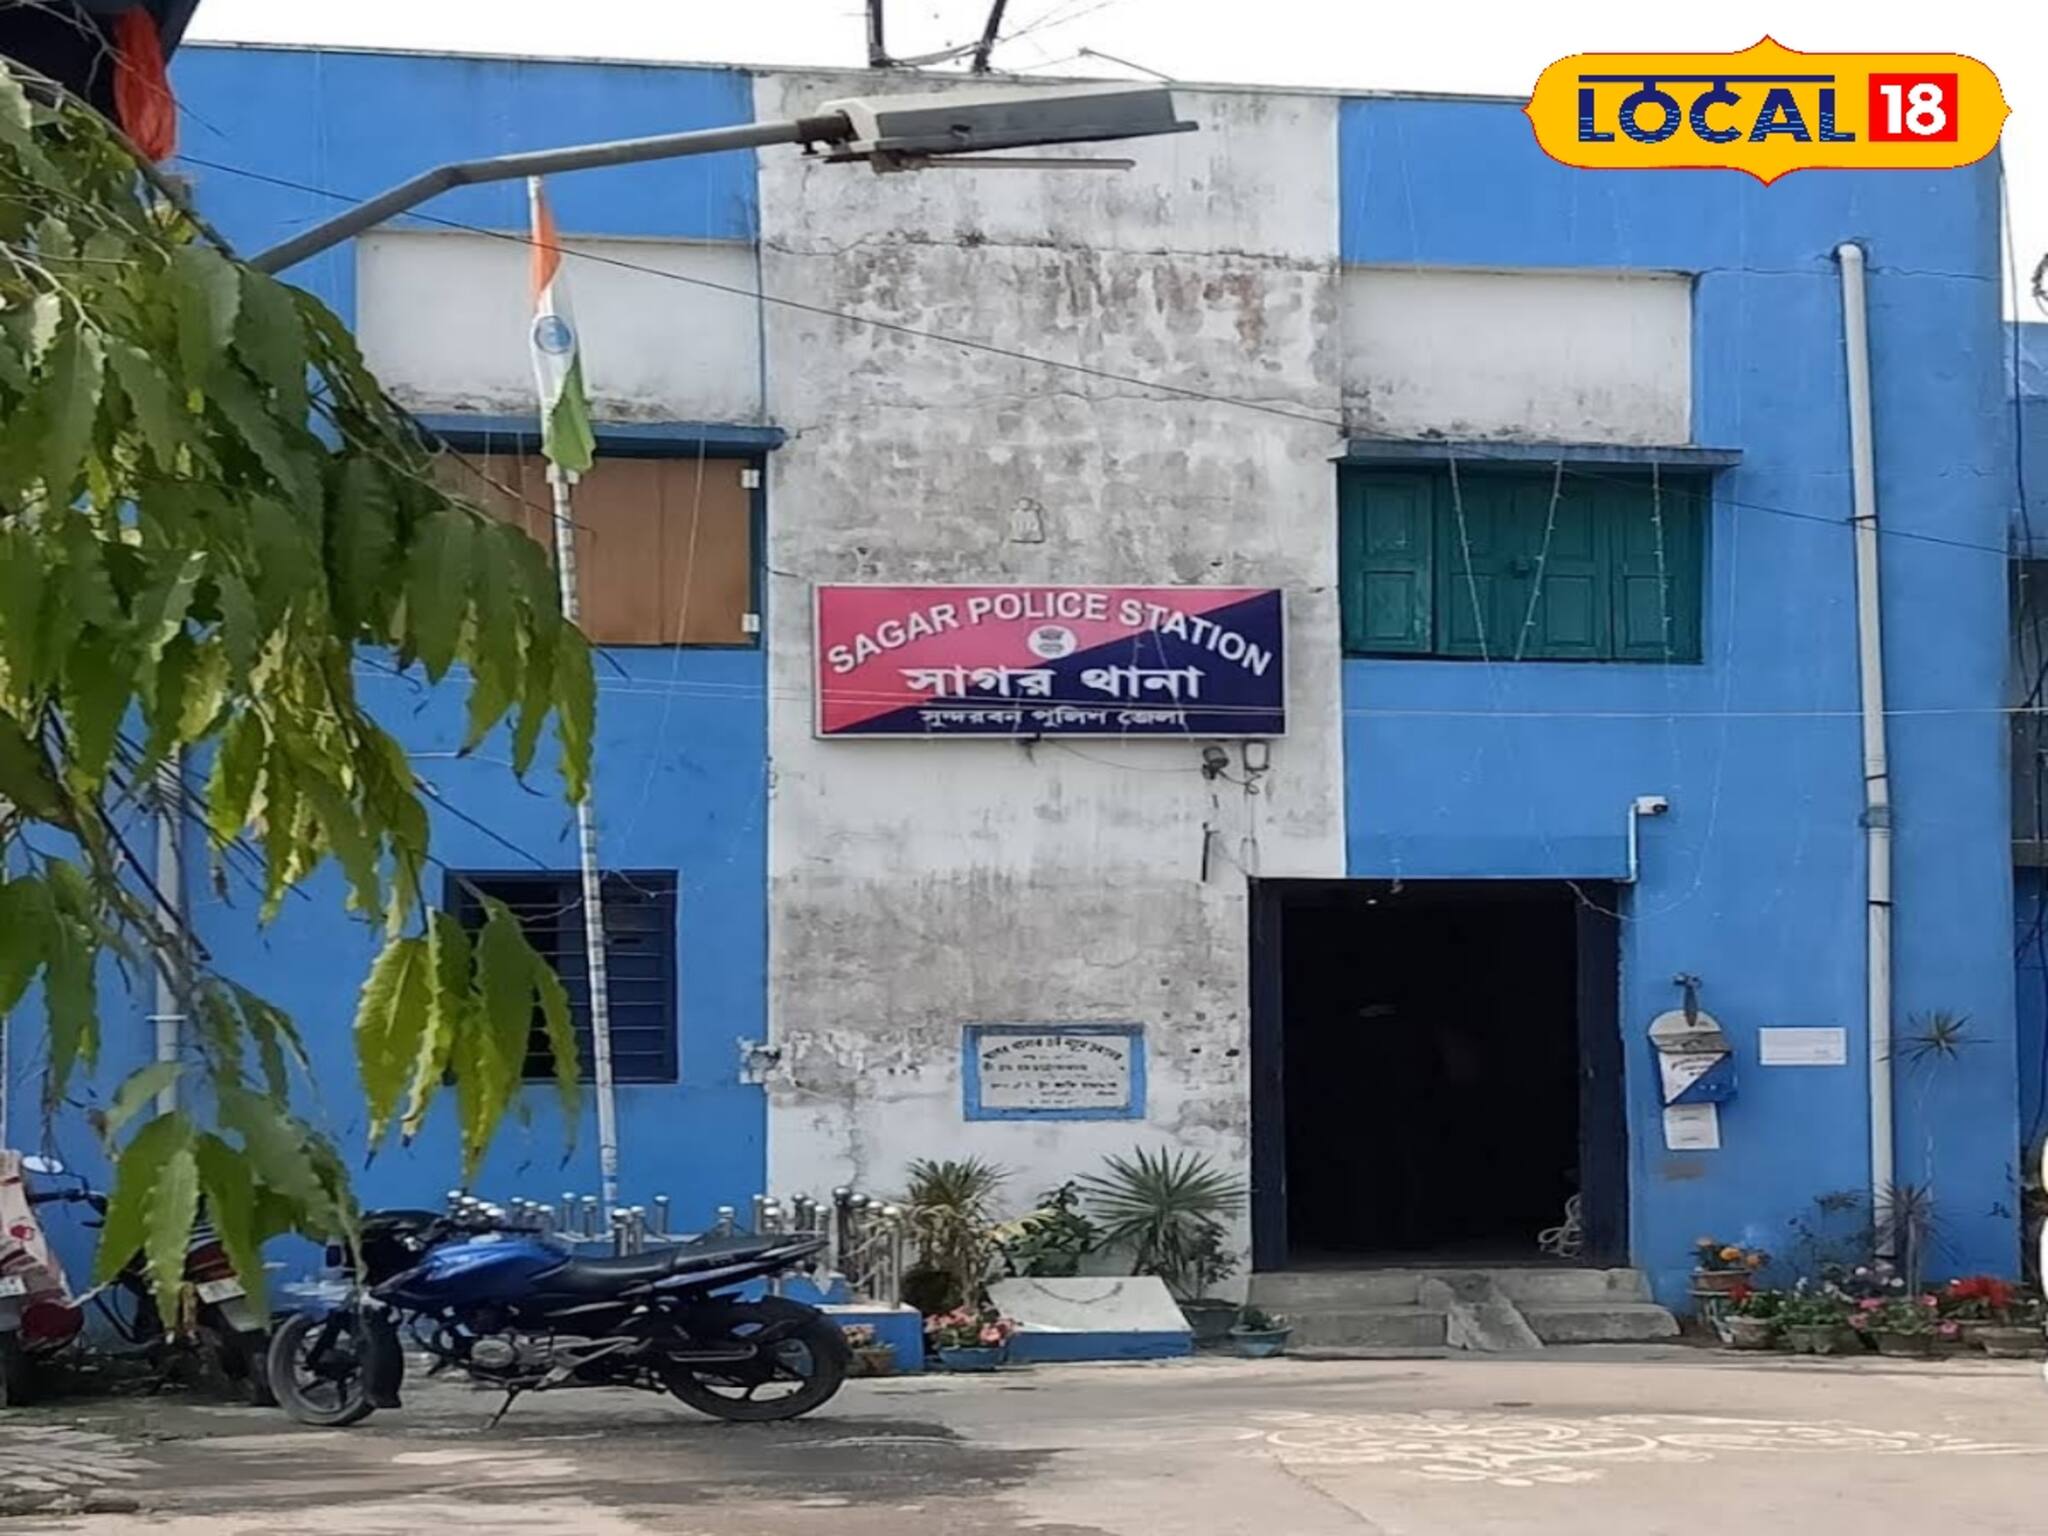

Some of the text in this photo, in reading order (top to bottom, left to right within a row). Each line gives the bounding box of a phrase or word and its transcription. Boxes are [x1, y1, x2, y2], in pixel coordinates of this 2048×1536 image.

[828, 592, 1271, 676] SAGAR POLICE STATION
[901, 665, 1205, 698] সাগর থানা
[920, 705, 1187, 728] সুন্দরবন পুলিশ জেলা
